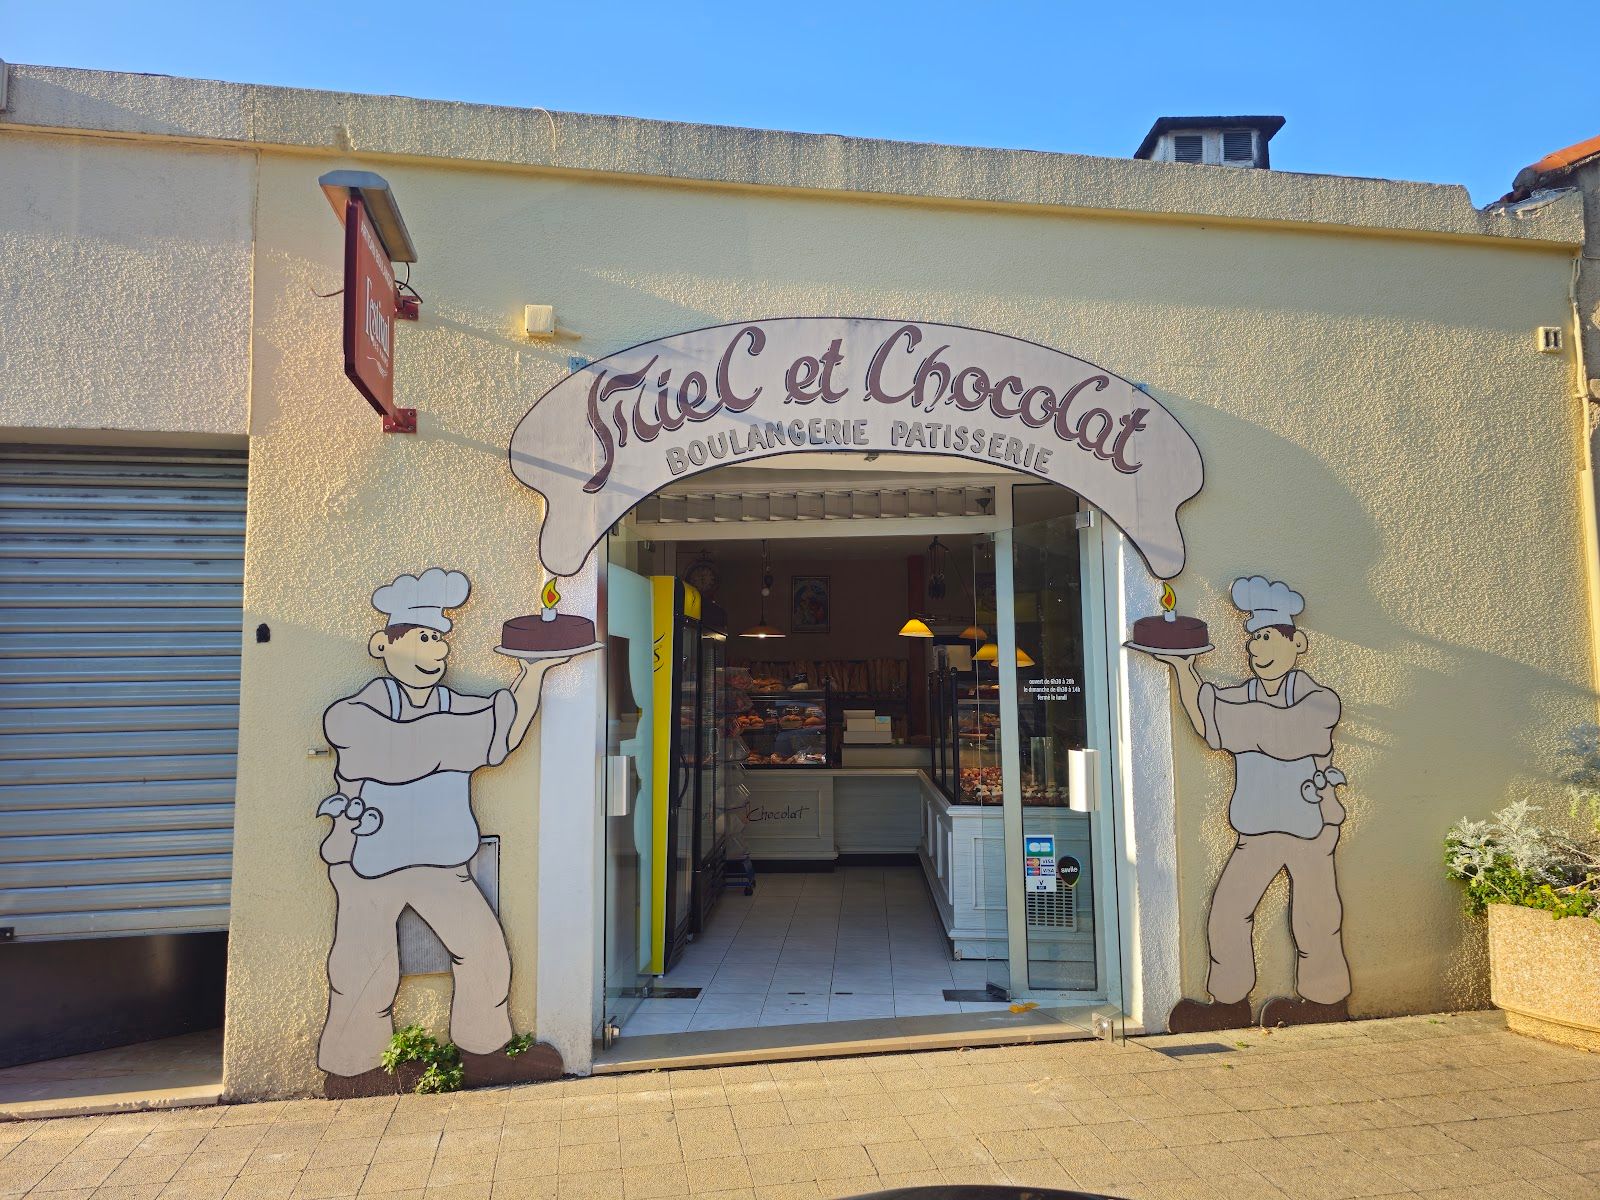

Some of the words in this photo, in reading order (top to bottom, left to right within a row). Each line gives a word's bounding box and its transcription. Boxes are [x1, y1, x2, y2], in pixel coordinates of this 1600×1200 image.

[583, 326, 766, 493] Miel
[784, 338, 849, 405] et
[865, 325, 1150, 474] Chocolat
[666, 417, 869, 476] BOULANGERIE
[891, 420, 1054, 475] PATISSERIE
[746, 805, 810, 822] Chocolat
[1028, 842, 1050, 852] CB
